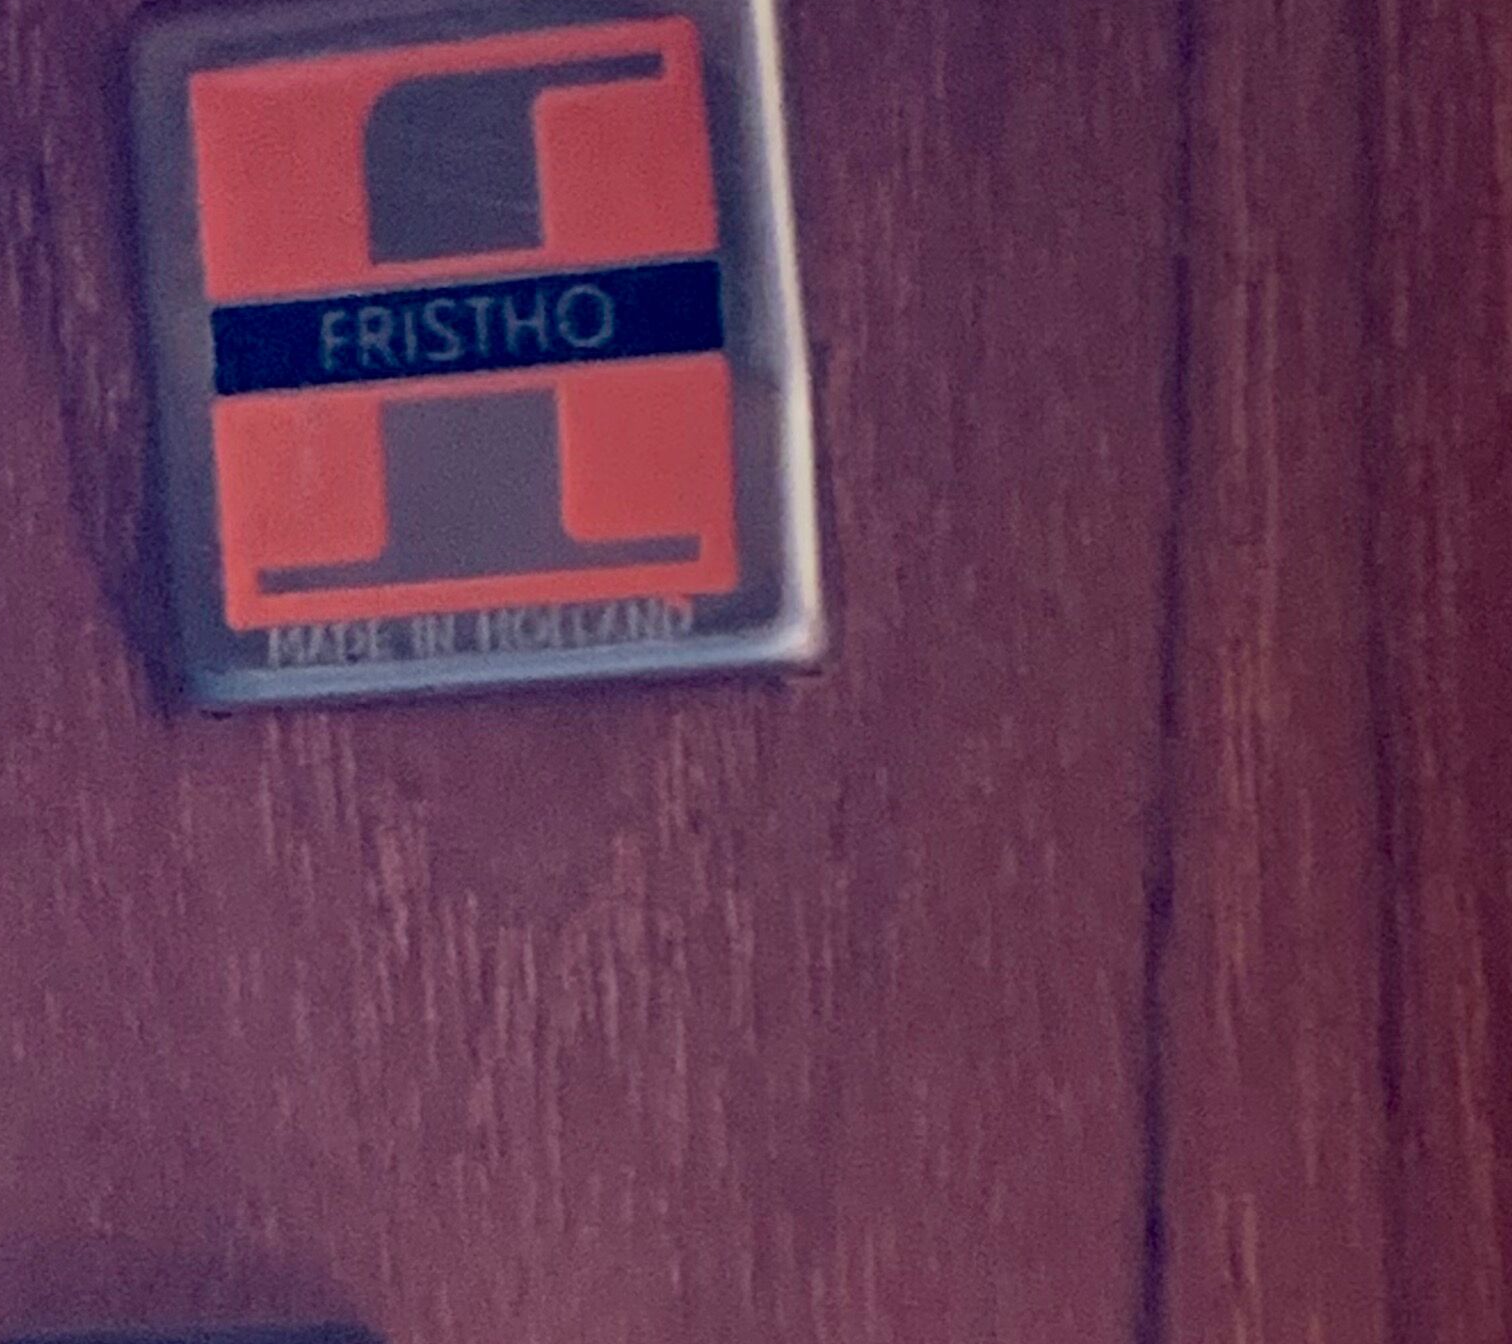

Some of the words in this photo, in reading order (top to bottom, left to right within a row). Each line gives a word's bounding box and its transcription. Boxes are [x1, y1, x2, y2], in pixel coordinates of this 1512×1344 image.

[320, 285, 616, 371] FRISTHO
[267, 620, 386, 666] MADE
[410, 612, 456, 654] IN
[476, 595, 694, 652] HOLLAND
